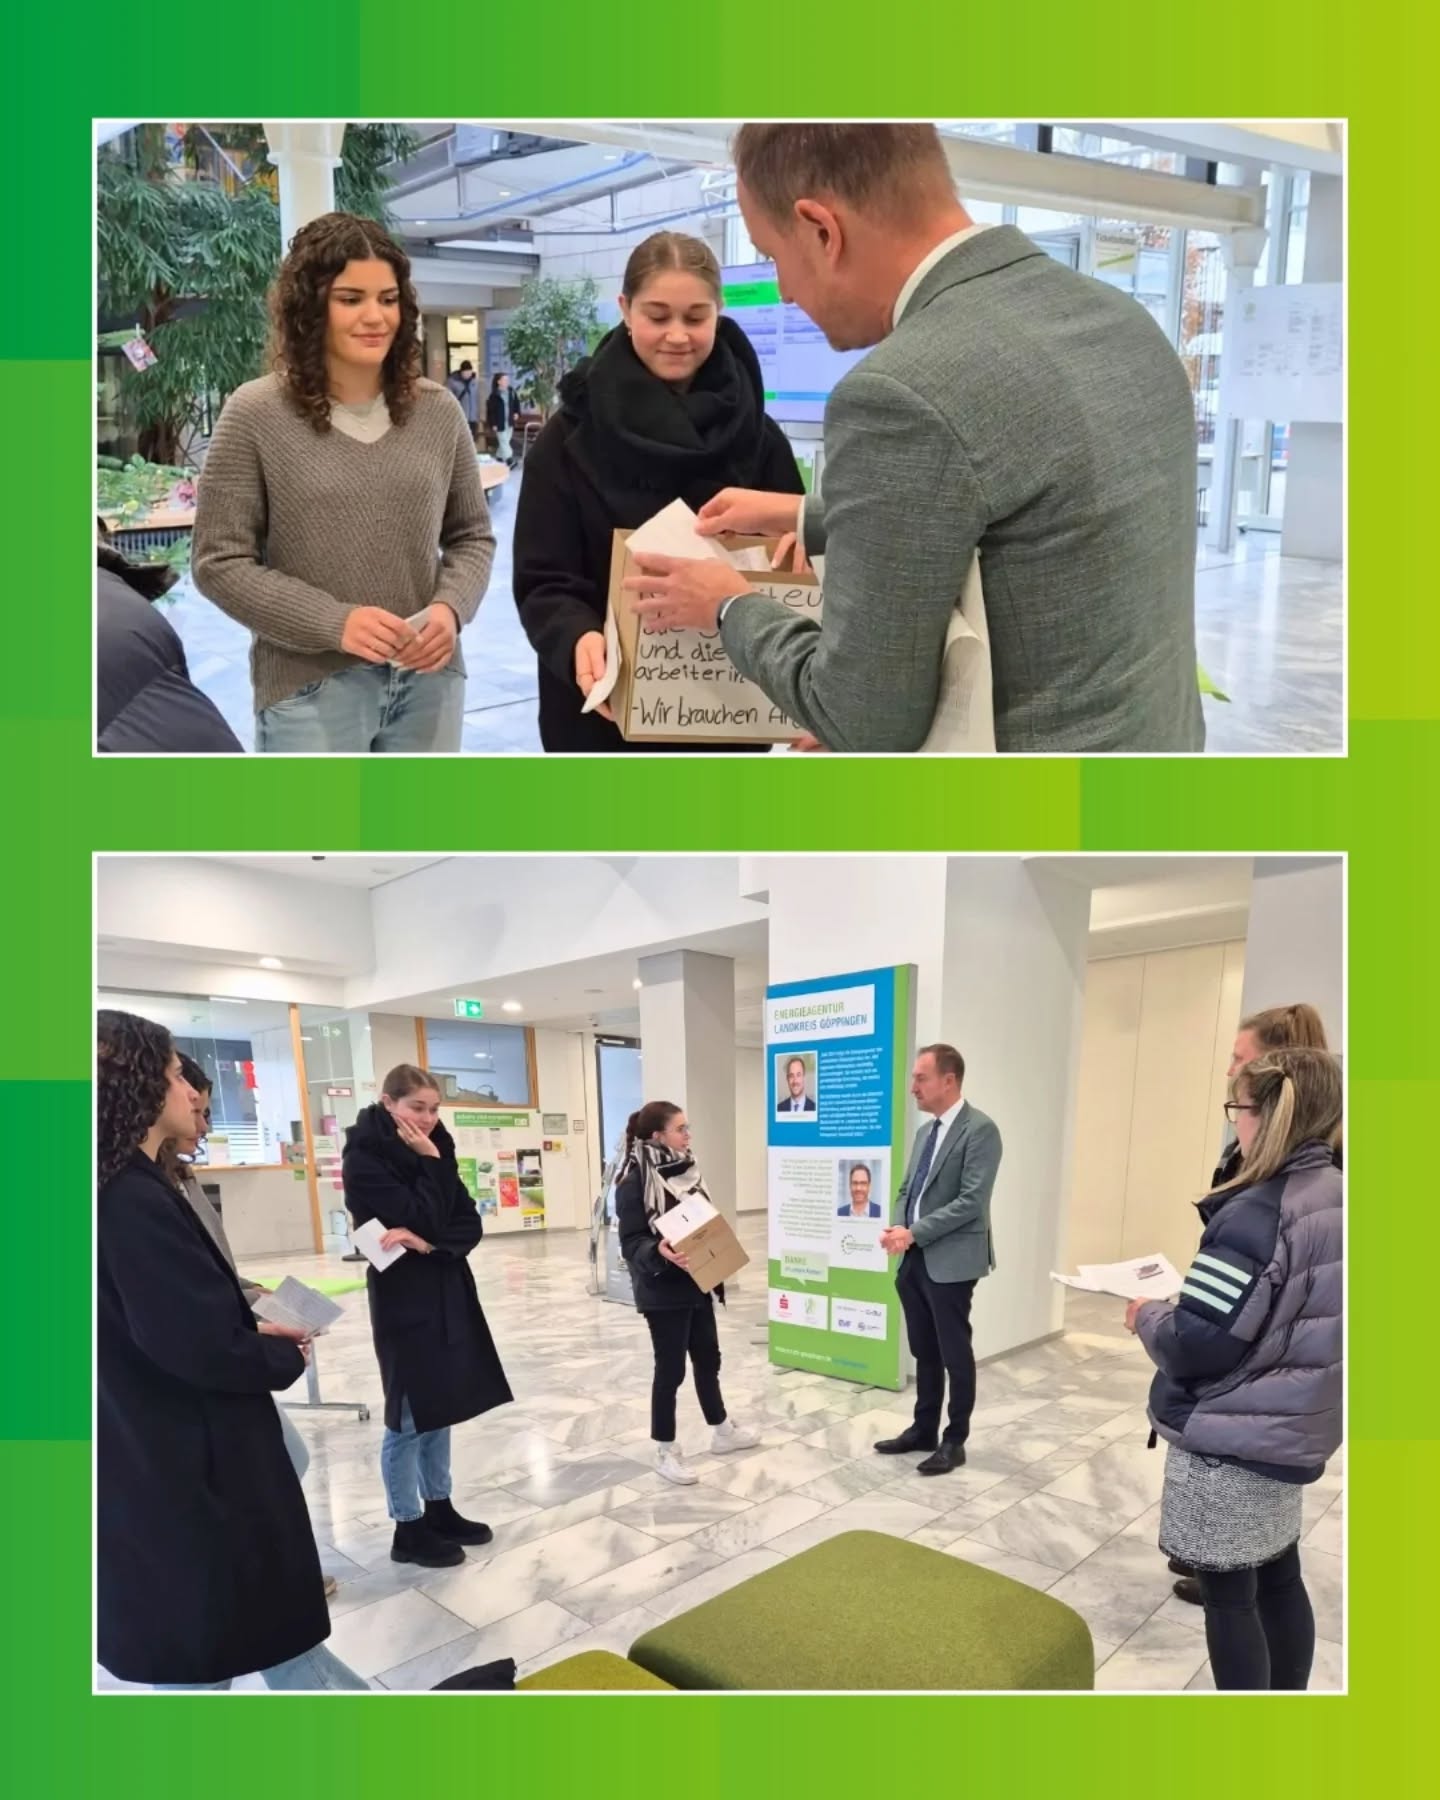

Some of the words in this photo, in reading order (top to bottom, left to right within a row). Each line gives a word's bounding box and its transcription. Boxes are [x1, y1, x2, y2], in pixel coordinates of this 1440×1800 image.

[640, 640, 683, 660] und
[691, 641, 726, 662] die
[678, 695, 758, 727] brauchen
[774, 1001, 845, 1020] ENERGIEAGENTUR
[774, 1020, 817, 1034] LANDKREIS
[820, 1013, 868, 1030] GÖPPINGEN
